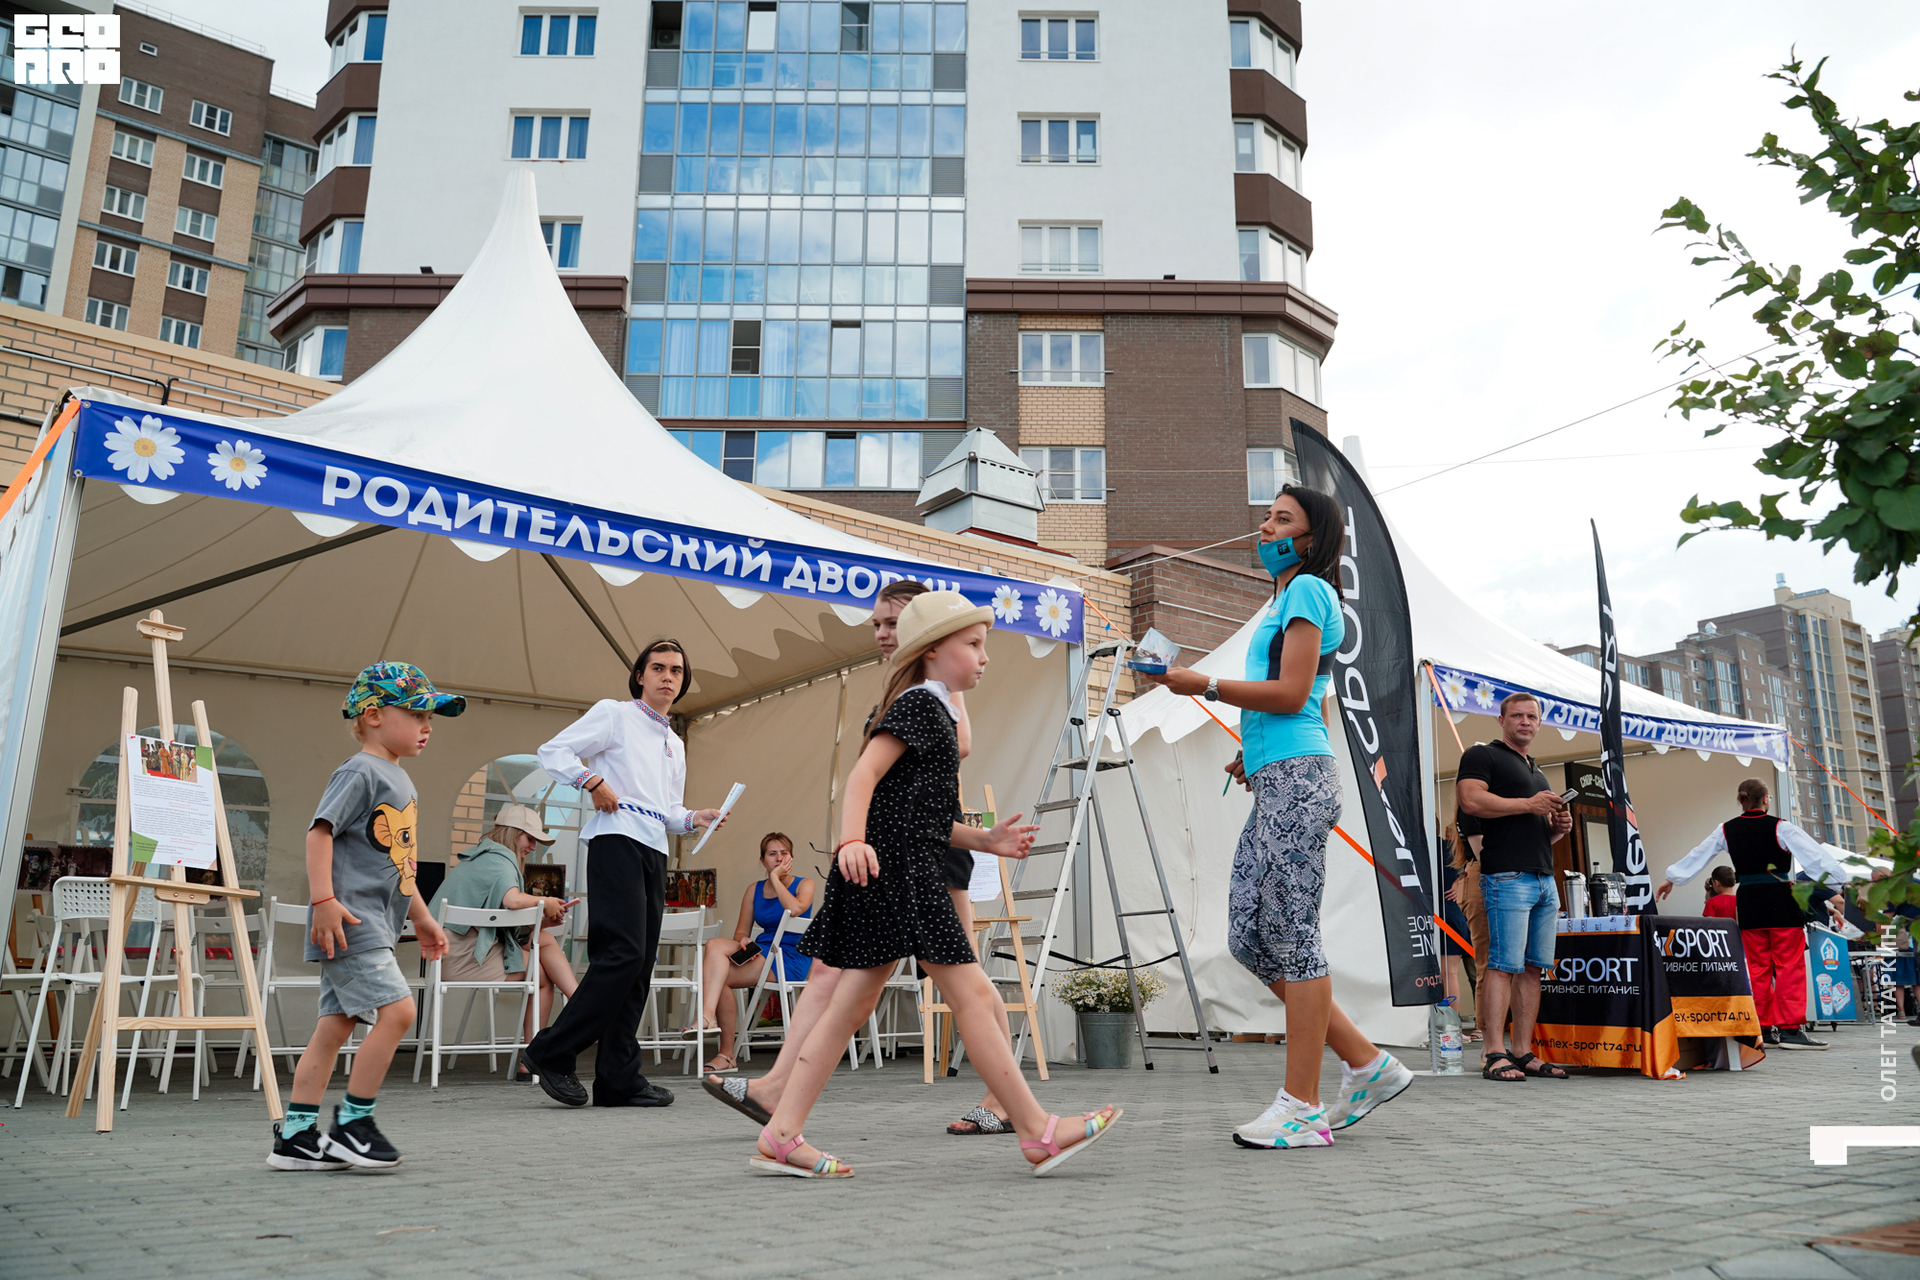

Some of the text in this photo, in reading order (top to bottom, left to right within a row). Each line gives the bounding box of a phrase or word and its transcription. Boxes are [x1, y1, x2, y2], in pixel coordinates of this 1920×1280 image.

[322, 465, 772, 582] РОДИТЕЛЬСКИЙ
[1661, 723, 1739, 751] ДВОРИК
[1701, 962, 1739, 972] ПИТАНИЕ
[1588, 985, 1640, 995] ПИТАНИЕ
